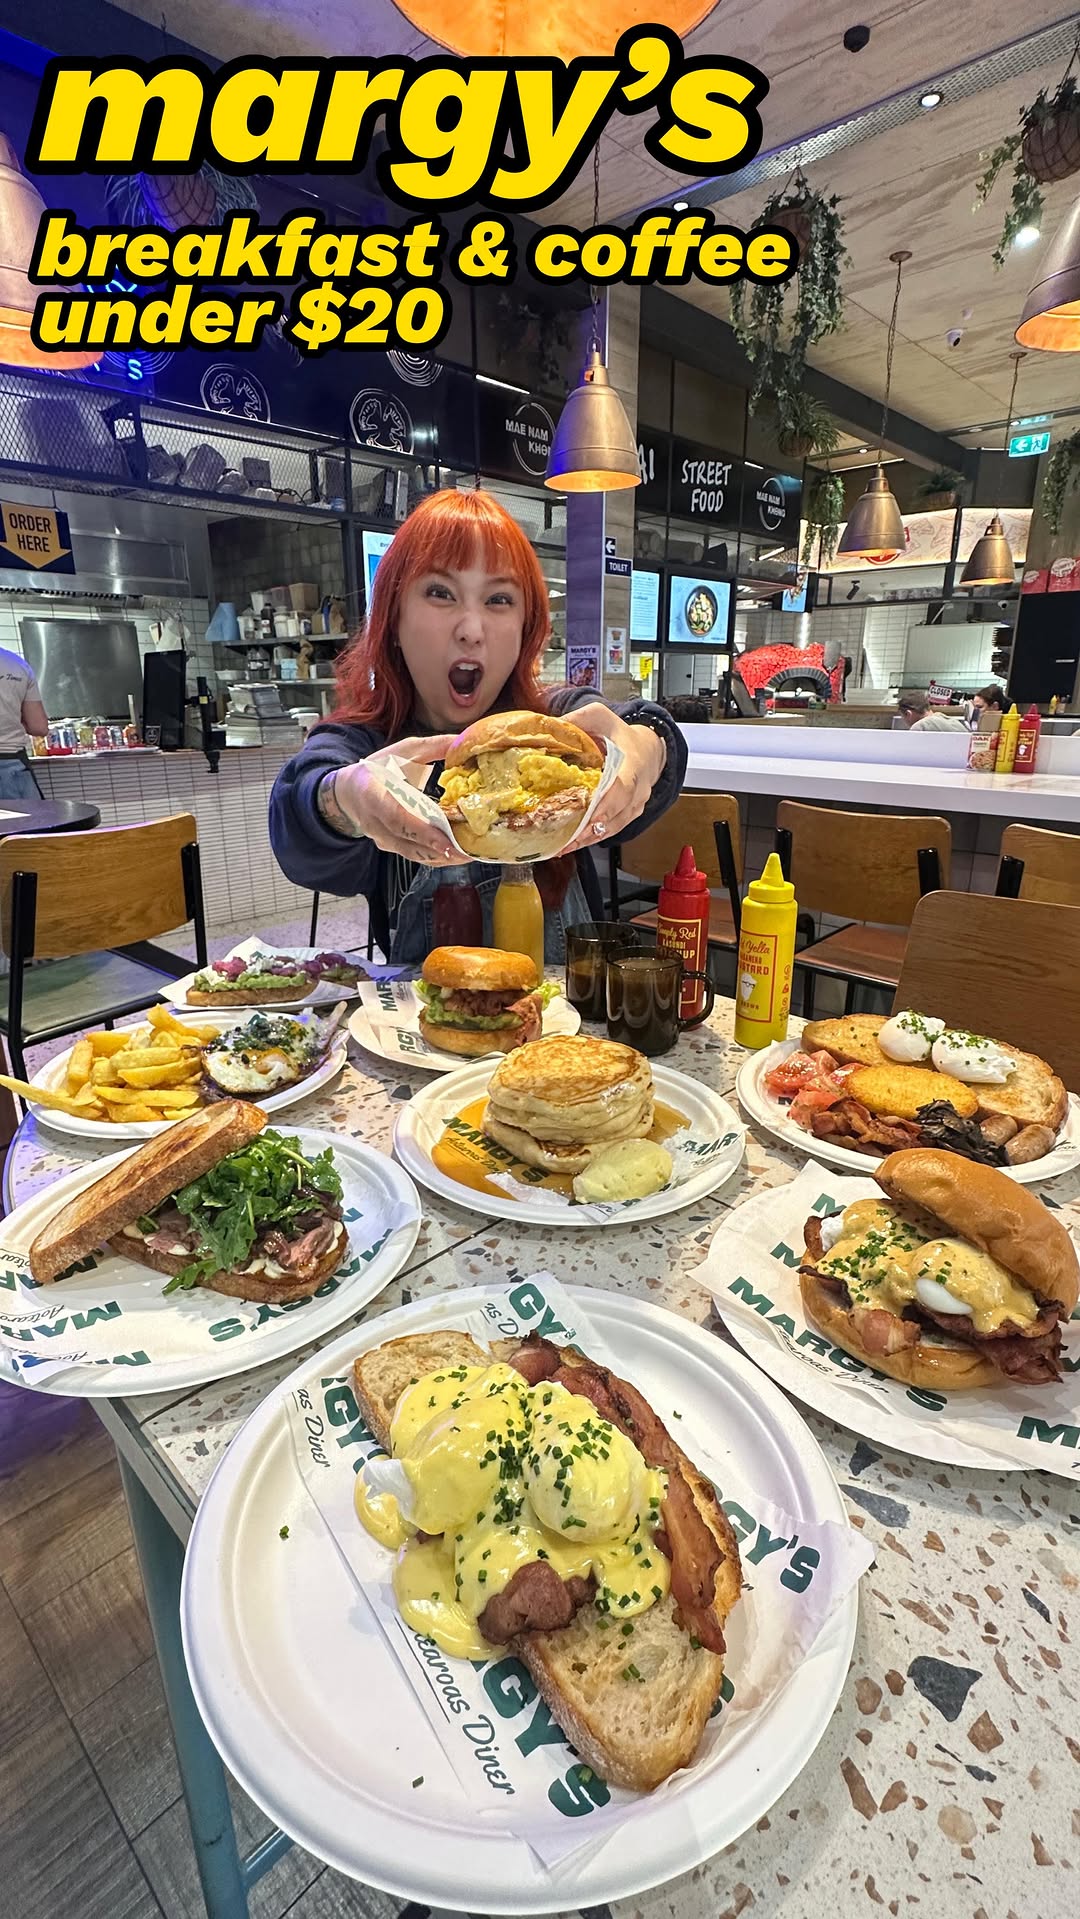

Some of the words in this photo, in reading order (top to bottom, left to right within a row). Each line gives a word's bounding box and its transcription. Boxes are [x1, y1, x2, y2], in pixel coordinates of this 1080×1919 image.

[505, 419, 526, 436] MAE
[528, 427, 549, 442] NAM
[681, 458, 733, 486] STREET
[690, 488, 724, 513] FOOD
[8, 512, 52, 533] ORDER
[16, 533, 51, 553] HERE
[609, 561, 629, 573] TOILET
[930, 686, 951, 697] CLOSED
[678, 926, 697, 940] Red
[304, 1414, 332, 1469] Diner
[461, 1713, 516, 1796] Diner
